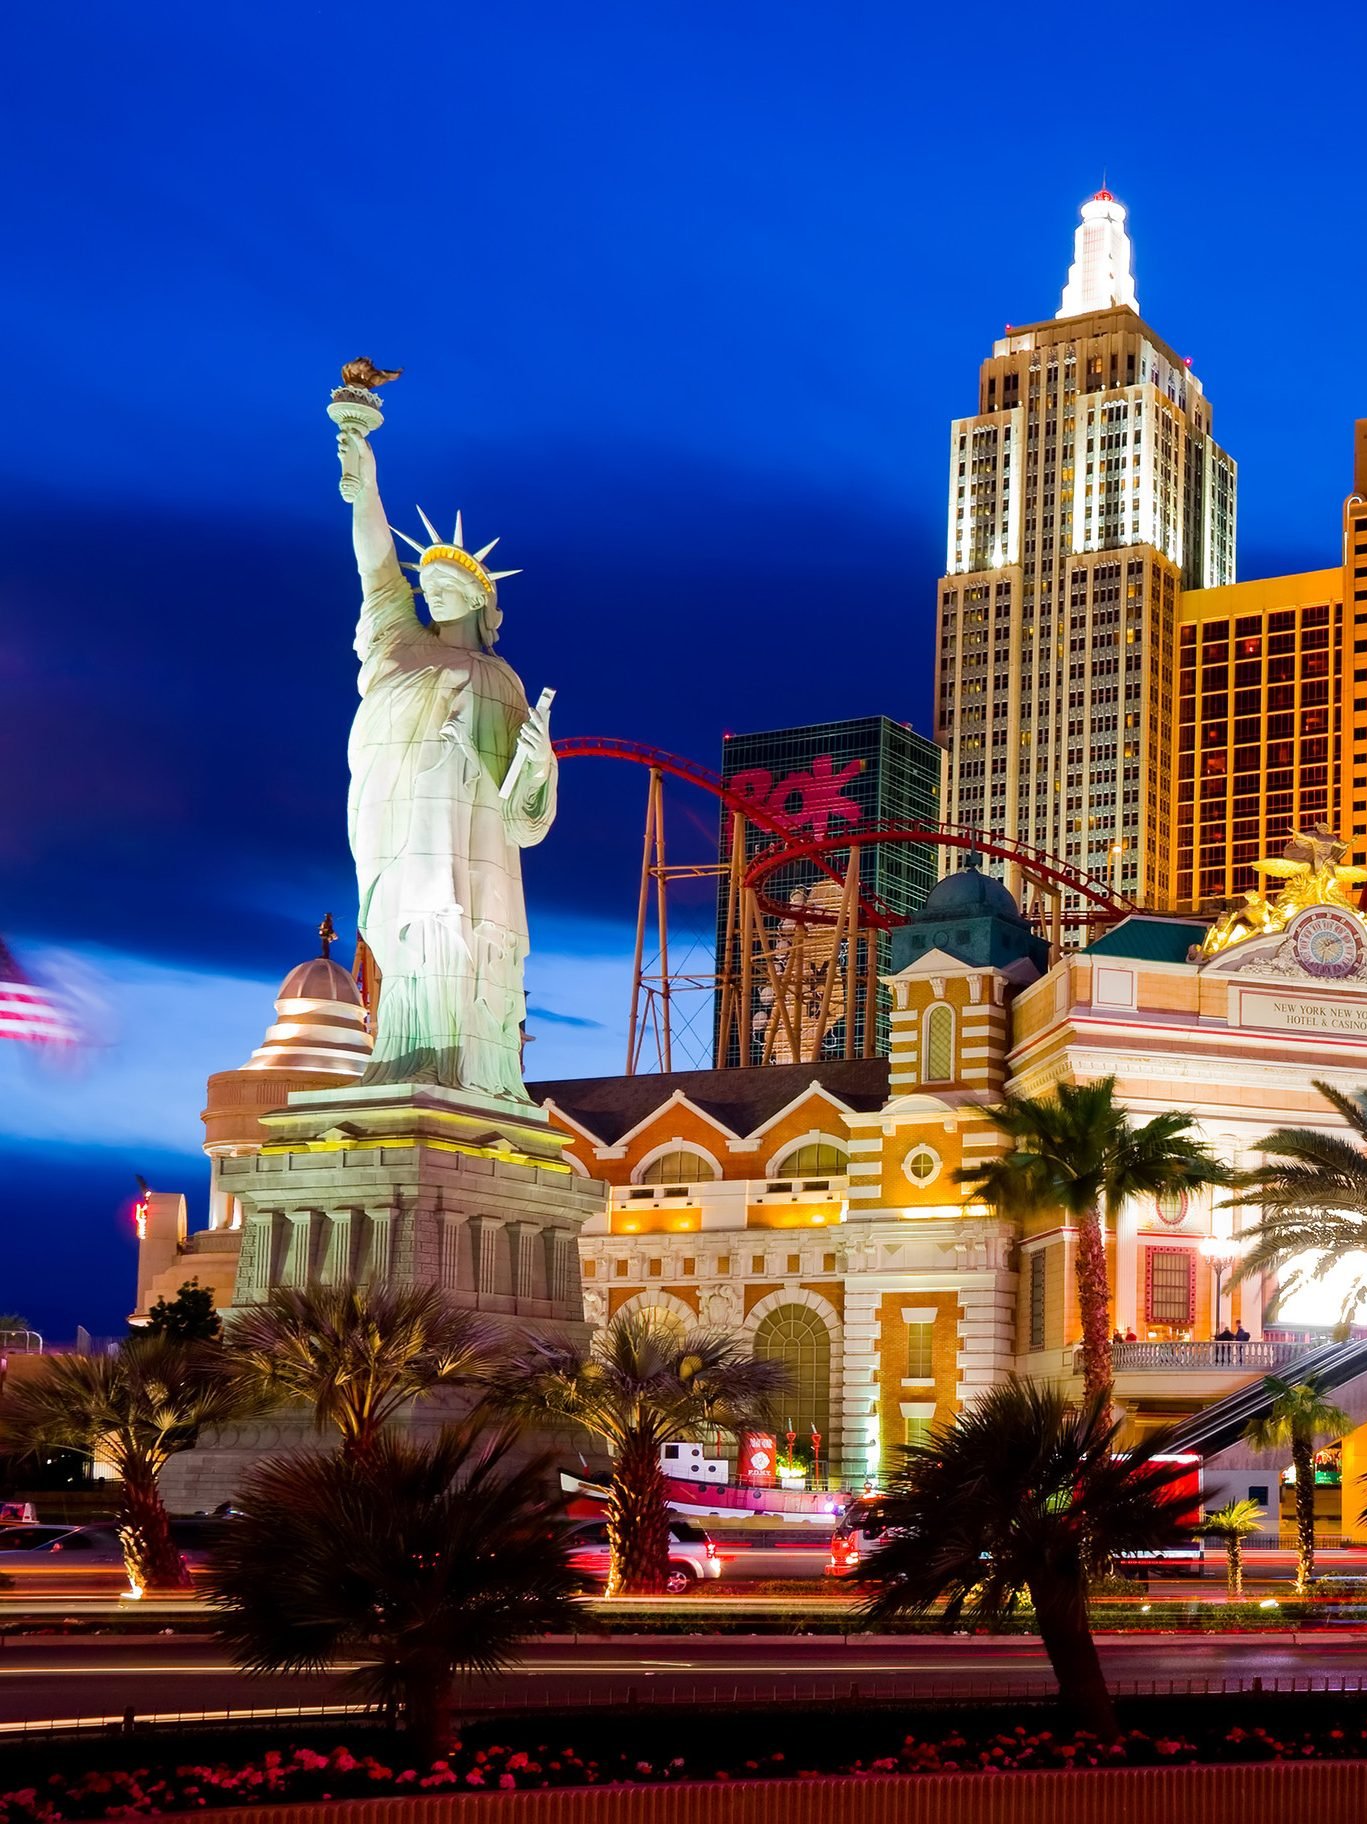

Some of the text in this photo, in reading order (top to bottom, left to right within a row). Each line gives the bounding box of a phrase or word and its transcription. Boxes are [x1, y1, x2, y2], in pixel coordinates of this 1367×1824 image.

[1274, 1003, 1296, 1013] NEW
[1300, 1005, 1326, 1016] YORK
[1330, 1008, 1352, 1018] NEW
[1286, 1015, 1318, 1026] HOTEL
[1331, 1020, 1367, 1030] CASINO
